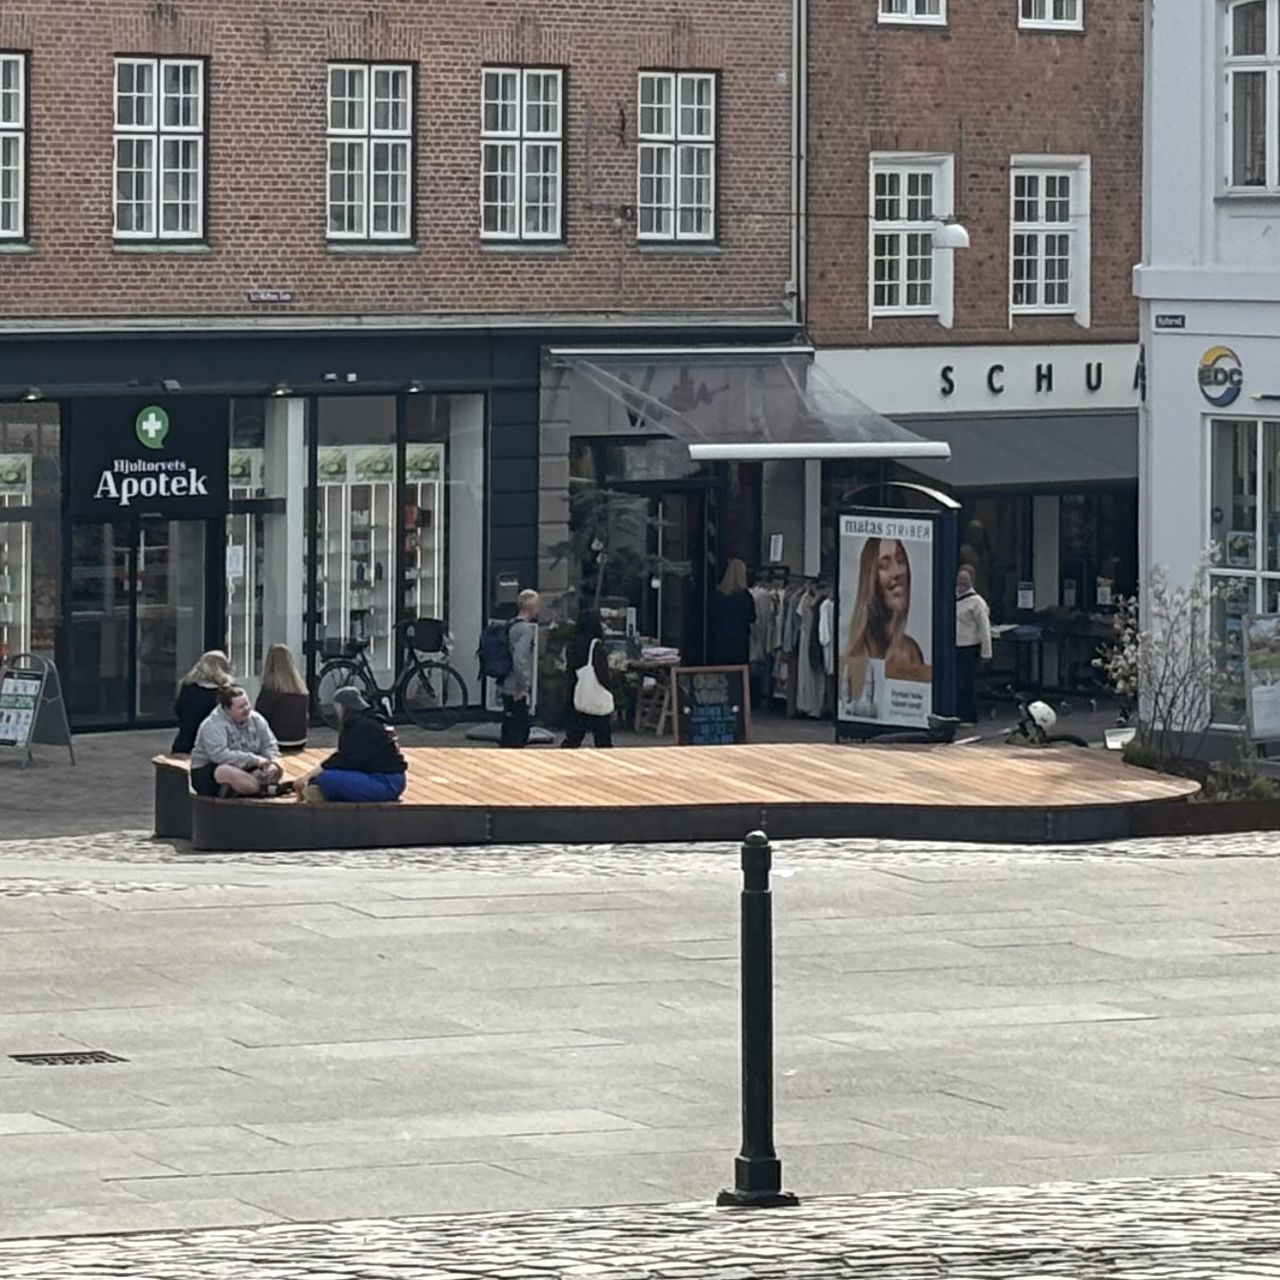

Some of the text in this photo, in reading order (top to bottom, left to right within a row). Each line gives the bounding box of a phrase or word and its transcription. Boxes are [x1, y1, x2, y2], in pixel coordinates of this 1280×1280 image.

[1199, 367, 1243, 386] EDC
[113, 459, 186, 474] Hjultorvets
[93, 467, 208, 506] Apotek
